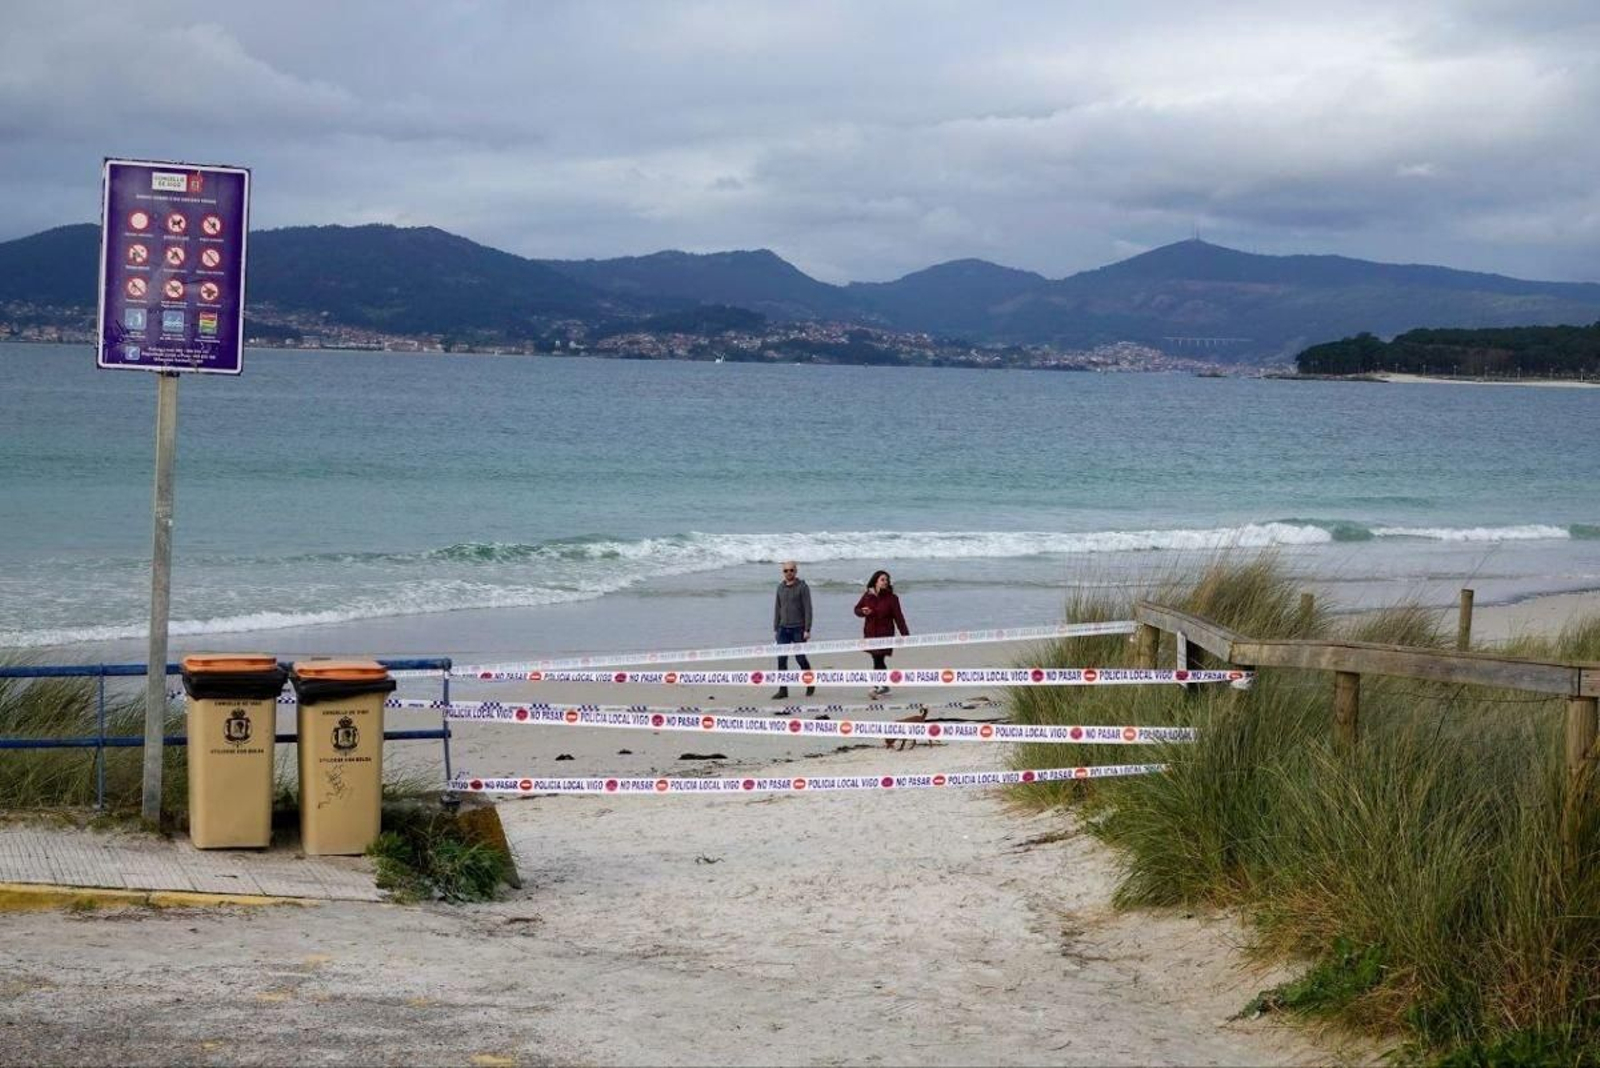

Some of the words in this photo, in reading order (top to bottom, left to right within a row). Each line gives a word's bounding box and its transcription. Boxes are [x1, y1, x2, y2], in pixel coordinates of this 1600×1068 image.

[544, 672, 570, 682] POLICIA
[572, 673, 593, 682] LOCAL
[596, 673, 612, 682] VIGO
[630, 674, 639, 683] NO
[641, 674, 663, 683] PASAR
[680, 674, 705, 684] POLICIA
[708, 674, 729, 683] LOCAL
[732, 674, 748, 683] VIGO
[766, 674, 775, 682] NO
[778, 673, 799, 682] PASAR
[817, 673, 843, 682] POLICIA
[846, 673, 868, 682] LOCAL
[870, 672, 887, 682] VIGO
[905, 672, 914, 681] NO
[917, 672, 939, 681] PASAR
[957, 671, 984, 681] POLICIA
[987, 671, 1009, 681] LOCAL
[1012, 671, 1028, 680] VIGO
[1047, 671, 1056, 680] NO
[1059, 671, 1081, 680] PASAR
[1100, 671, 1127, 680] POLICIA
[1130, 671, 1152, 680] LOCAL
[1156, 671, 1173, 680] VIGO
[473, 709, 494, 719] LOCAL
[496, 709, 513, 719] VIGO
[530, 710, 540, 720] NO
[542, 711, 564, 721] PASAR
[580, 713, 607, 723] POLICIA
[609, 714, 631, 724] LOCAL
[633, 714, 649, 724] VIGO
[667, 715, 676, 725] NO
[678, 715, 700, 726] PASAR
[717, 718, 744, 729] POLICIA
[746, 719, 767, 730] LOCAL
[770, 721, 786, 730] VIGO
[804, 722, 814, 731] NO
[816, 722, 837, 732] PASAR
[855, 723, 882, 733] POLICIA
[884, 724, 906, 734] LOCAL
[908, 724, 925, 734] VIGO
[944, 725, 953, 735] NO
[955, 726, 977, 735] PASAR
[996, 727, 1022, 737] POLICIA
[1025, 728, 1047, 737] LOCAL
[1050, 728, 1067, 738] VIGO
[1086, 729, 1096, 738] NO
[1098, 729, 1120, 738] PASAR
[948, 775, 975, 785] POLICIA
[978, 774, 999, 784] LOCAL
[1002, 773, 1019, 782] VIGO
[1038, 771, 1047, 780] NO
[1050, 770, 1072, 779] PASAR
[485, 780, 494, 789] NO
[496, 780, 518, 789] PASAR
[534, 780, 561, 790] POLICIA
[563, 780, 584, 790] LOCAL
[587, 780, 603, 790] VIGO
[621, 780, 630, 790] NO
[632, 780, 653, 790] PASAR
[671, 780, 697, 790] POLICIA
[700, 780, 721, 790] LOCAL
[723, 780, 739, 789] VIGO
[757, 780, 767, 789] NO
[769, 779, 791, 789] PASAR
[808, 779, 835, 788] POLICIA
[837, 779, 859, 788] LOCAL
[862, 778, 878, 787] VIGO
[896, 777, 905, 786] NO
[908, 777, 930, 786] PASAR
